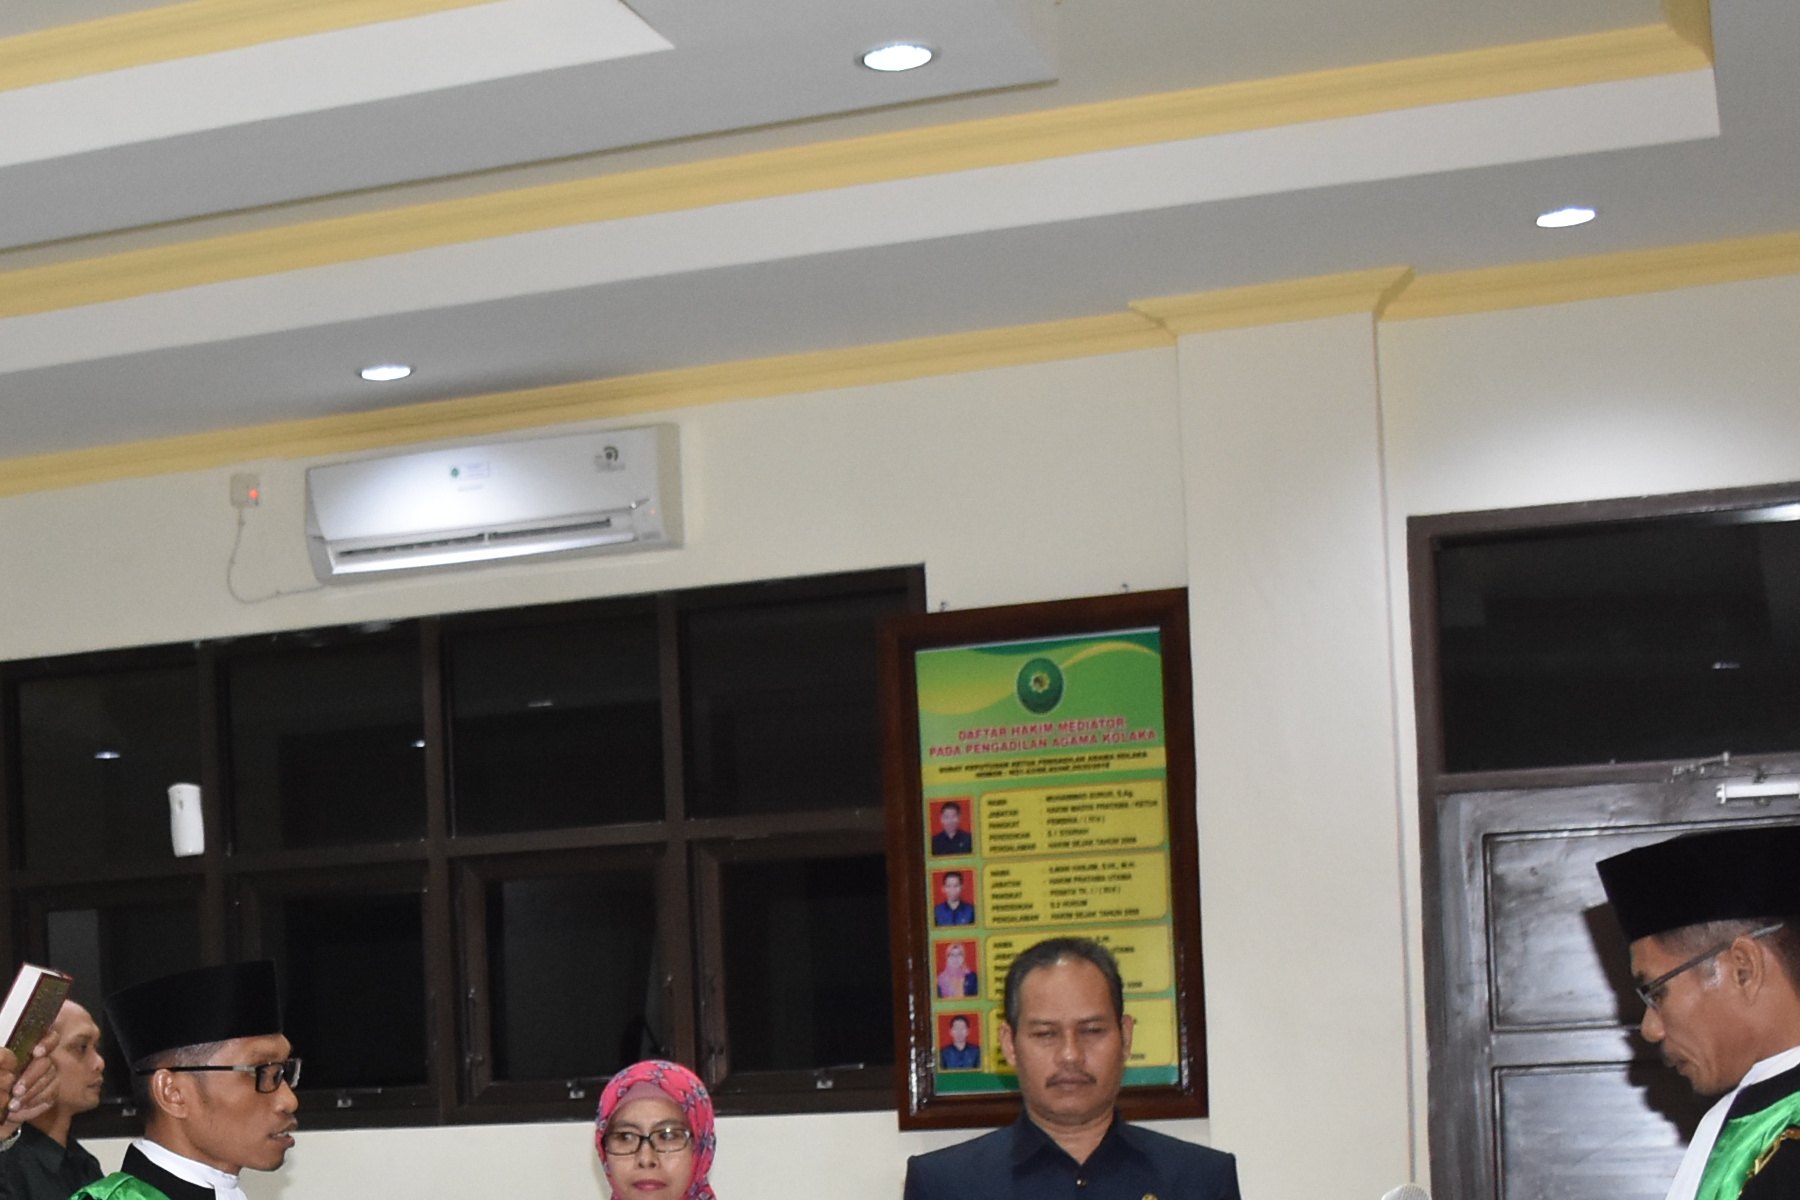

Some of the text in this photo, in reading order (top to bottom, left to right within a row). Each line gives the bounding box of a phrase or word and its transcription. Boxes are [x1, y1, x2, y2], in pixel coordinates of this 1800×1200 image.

[959, 716, 1125, 741] DAFTAR HAKIM MEDIATOR
[929, 729, 1157, 757] PADA PENGADILAN AGAMA KOLAKA
